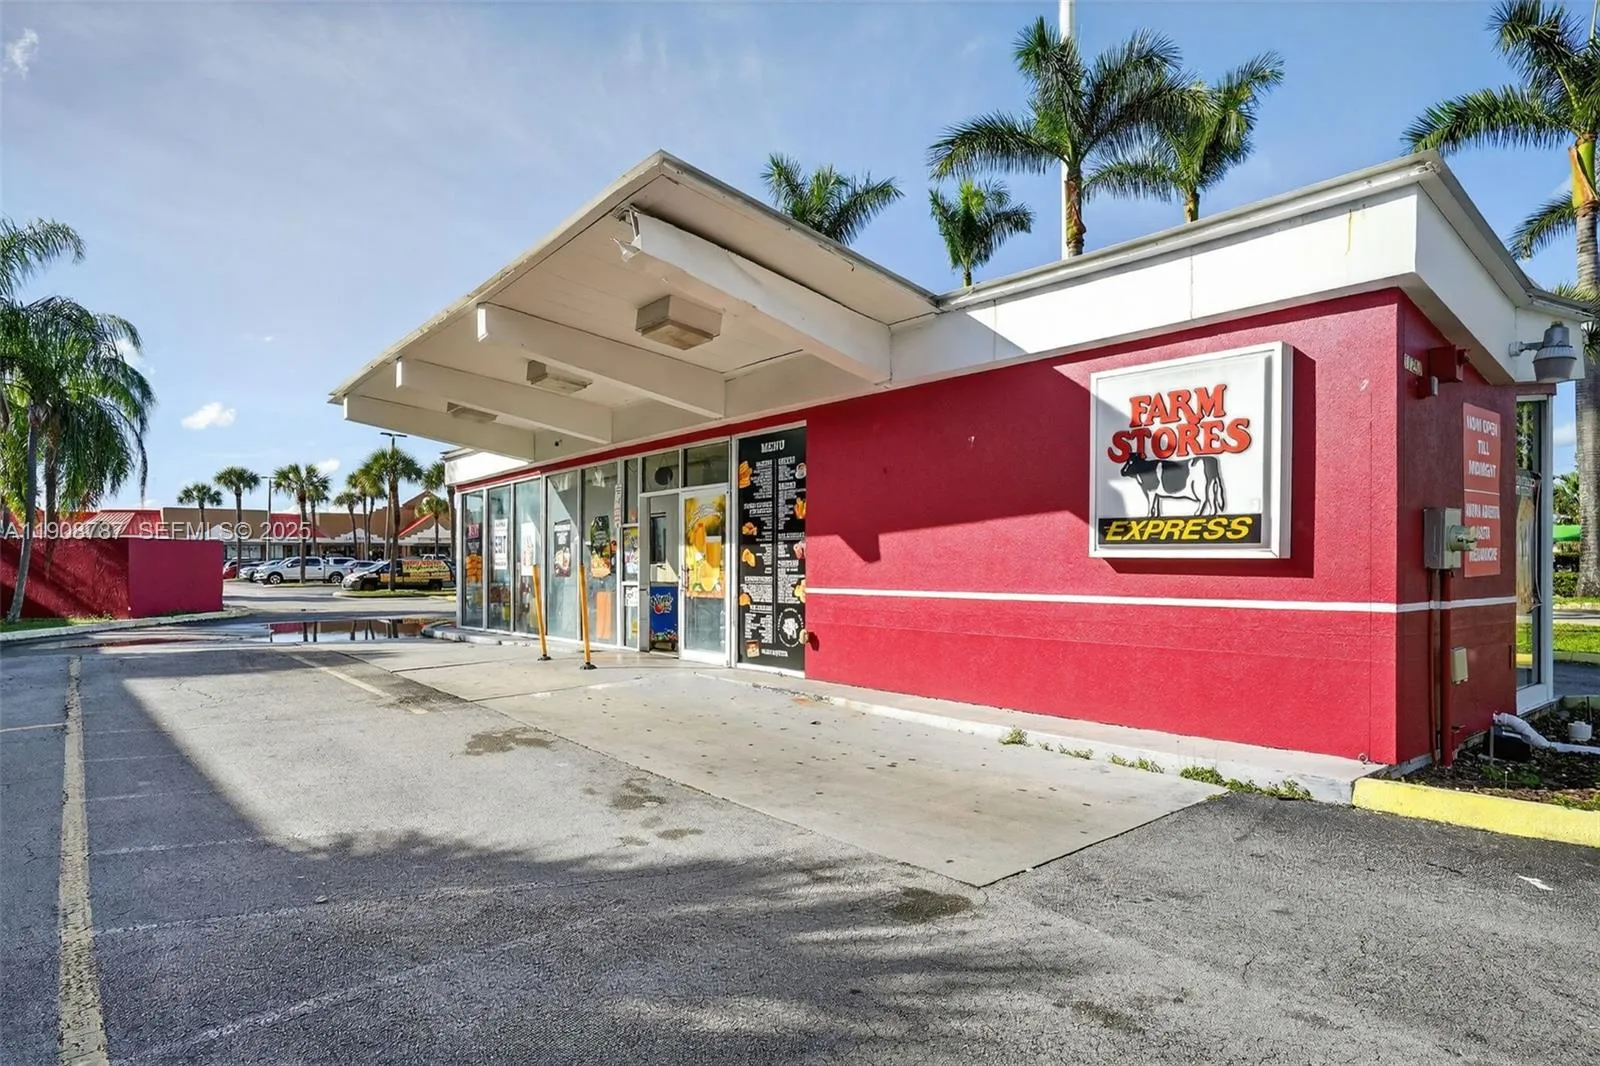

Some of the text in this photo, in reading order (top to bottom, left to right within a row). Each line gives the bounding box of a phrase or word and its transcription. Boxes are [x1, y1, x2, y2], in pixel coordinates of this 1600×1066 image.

[1129, 384, 1227, 427] FARM
[1466, 415, 1498, 436] NOW OPEN
[760, 440, 786, 454] MENU
[1107, 418, 1252, 463] STORES
[1477, 440, 1490, 455] TILL
[1105, 516, 1254, 541] EXPRESS
